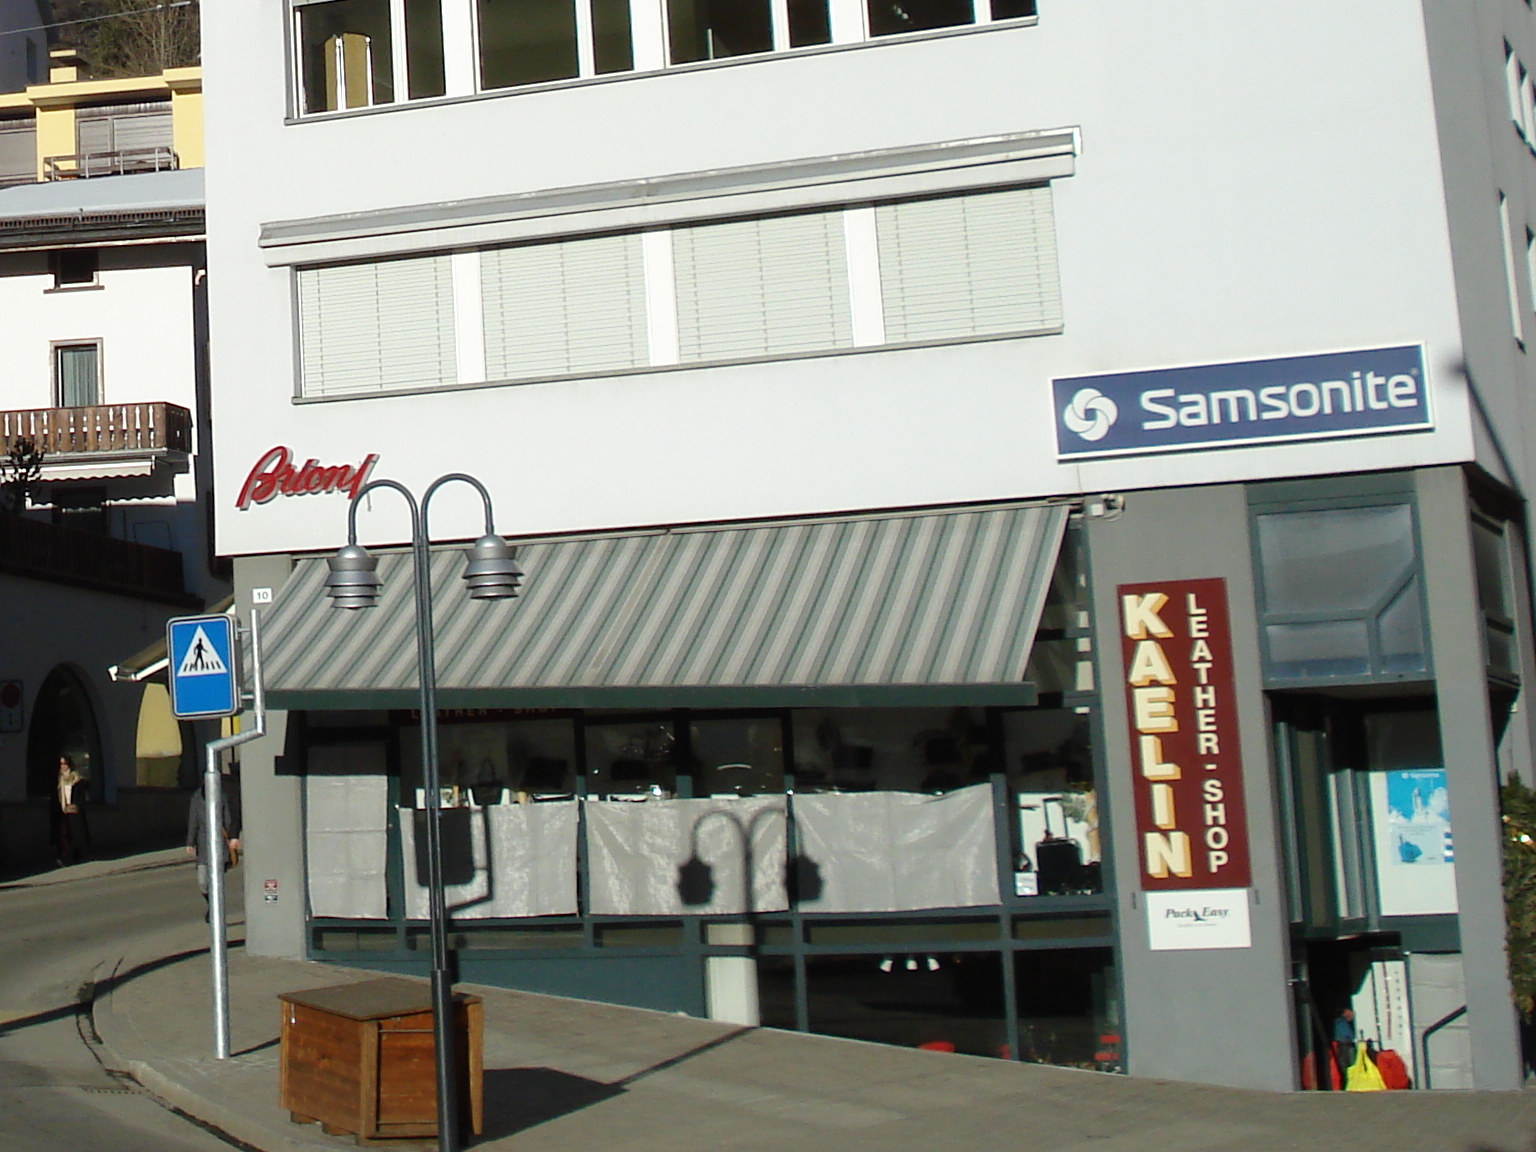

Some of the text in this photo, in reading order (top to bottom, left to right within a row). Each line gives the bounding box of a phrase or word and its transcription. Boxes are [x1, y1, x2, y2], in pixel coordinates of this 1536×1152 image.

[1141, 370, 1419, 431] Samsonite
[256, 591, 269, 601] 10
[1122, 592, 1193, 879] KAELIN
[1202, 907, 1230, 919] Easy
